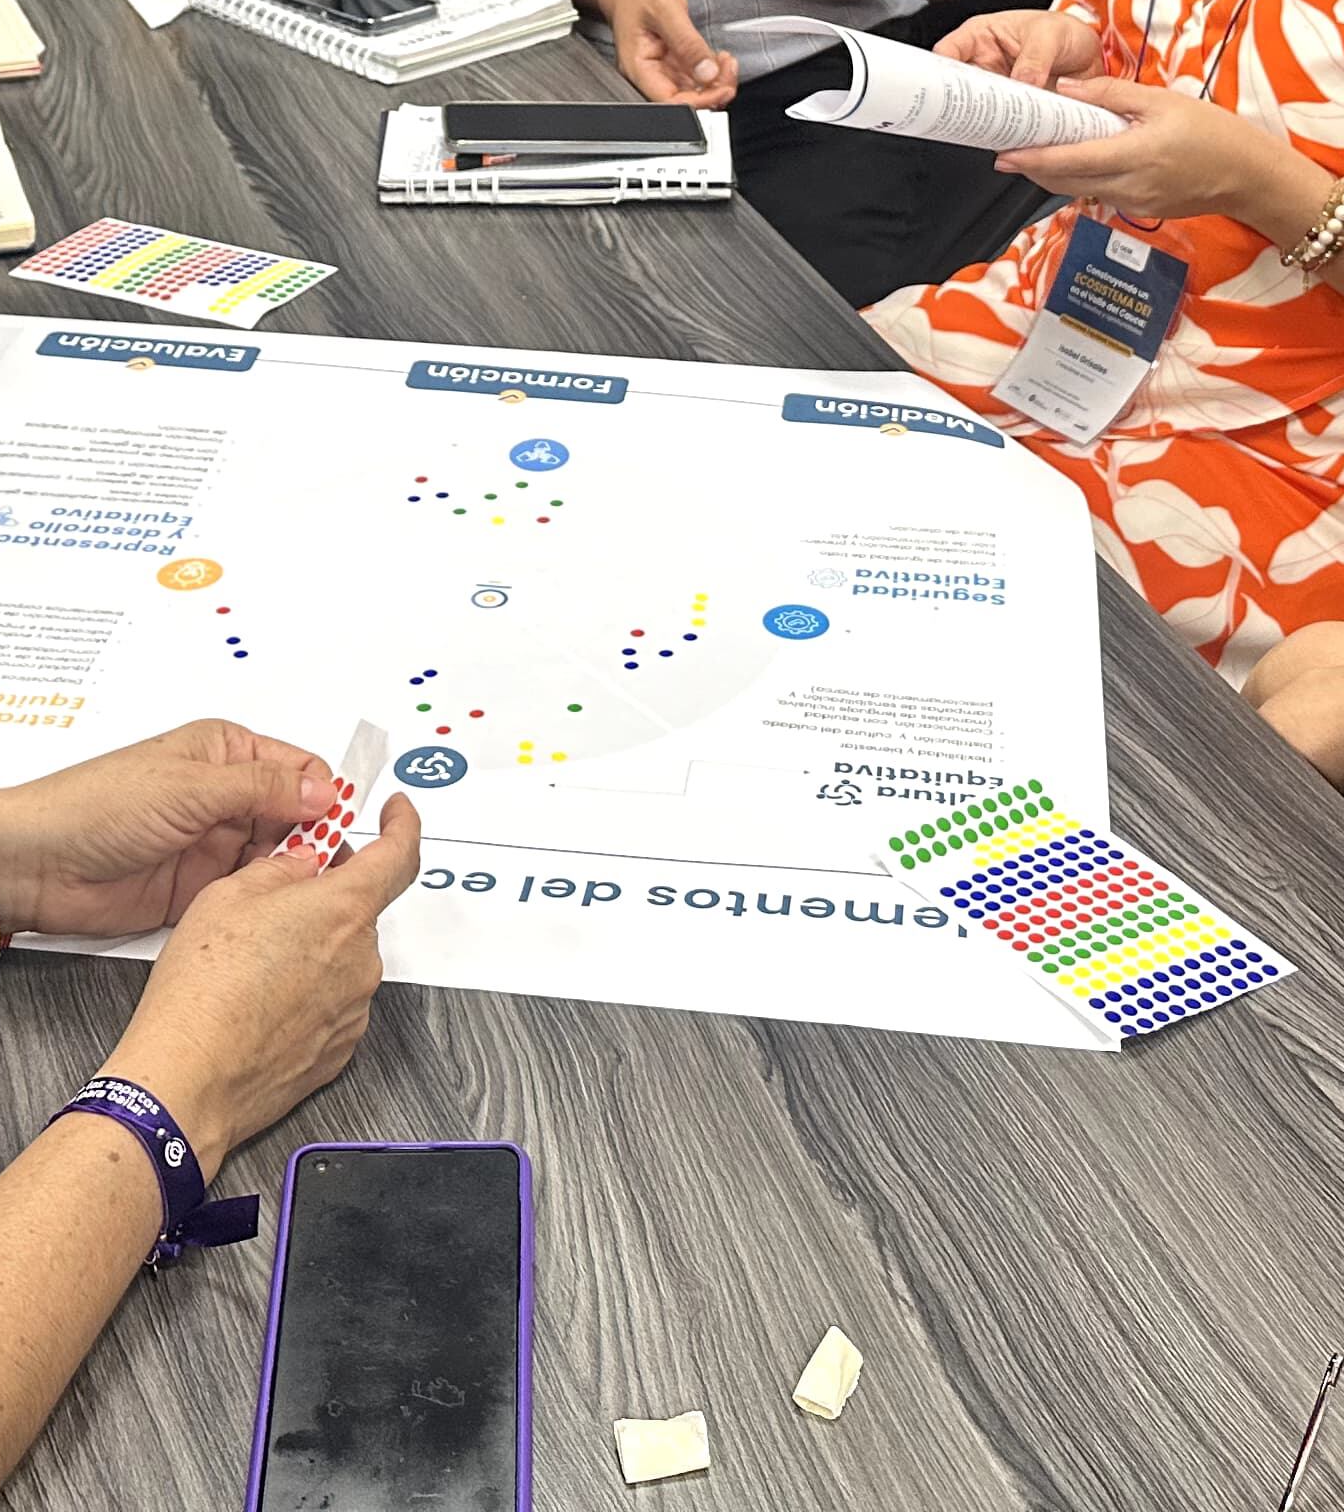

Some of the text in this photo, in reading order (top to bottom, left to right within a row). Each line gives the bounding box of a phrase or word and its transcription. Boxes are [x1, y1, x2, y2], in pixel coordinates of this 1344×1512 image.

[1074, 272, 1134, 309] ECOSISTEMA
[57, 334, 246, 361] Evaluación
[428, 364, 612, 395] Formación
[815, 400, 974, 433] Medición
[51, 508, 192, 526] Equitativo
[29, 522, 184, 540] y desarollo
[856, 569, 1005, 589] Equitativa
[852, 584, 1005, 605] Seguridad
[834, 762, 1003, 790] Equitativa
[878, 786, 975, 805] ultura
[519, 876, 621, 906] del
[648, 885, 966, 937] ementos
[106, 1080, 160, 1115] zapatos
[107, 1090, 146, 1117] bailar
